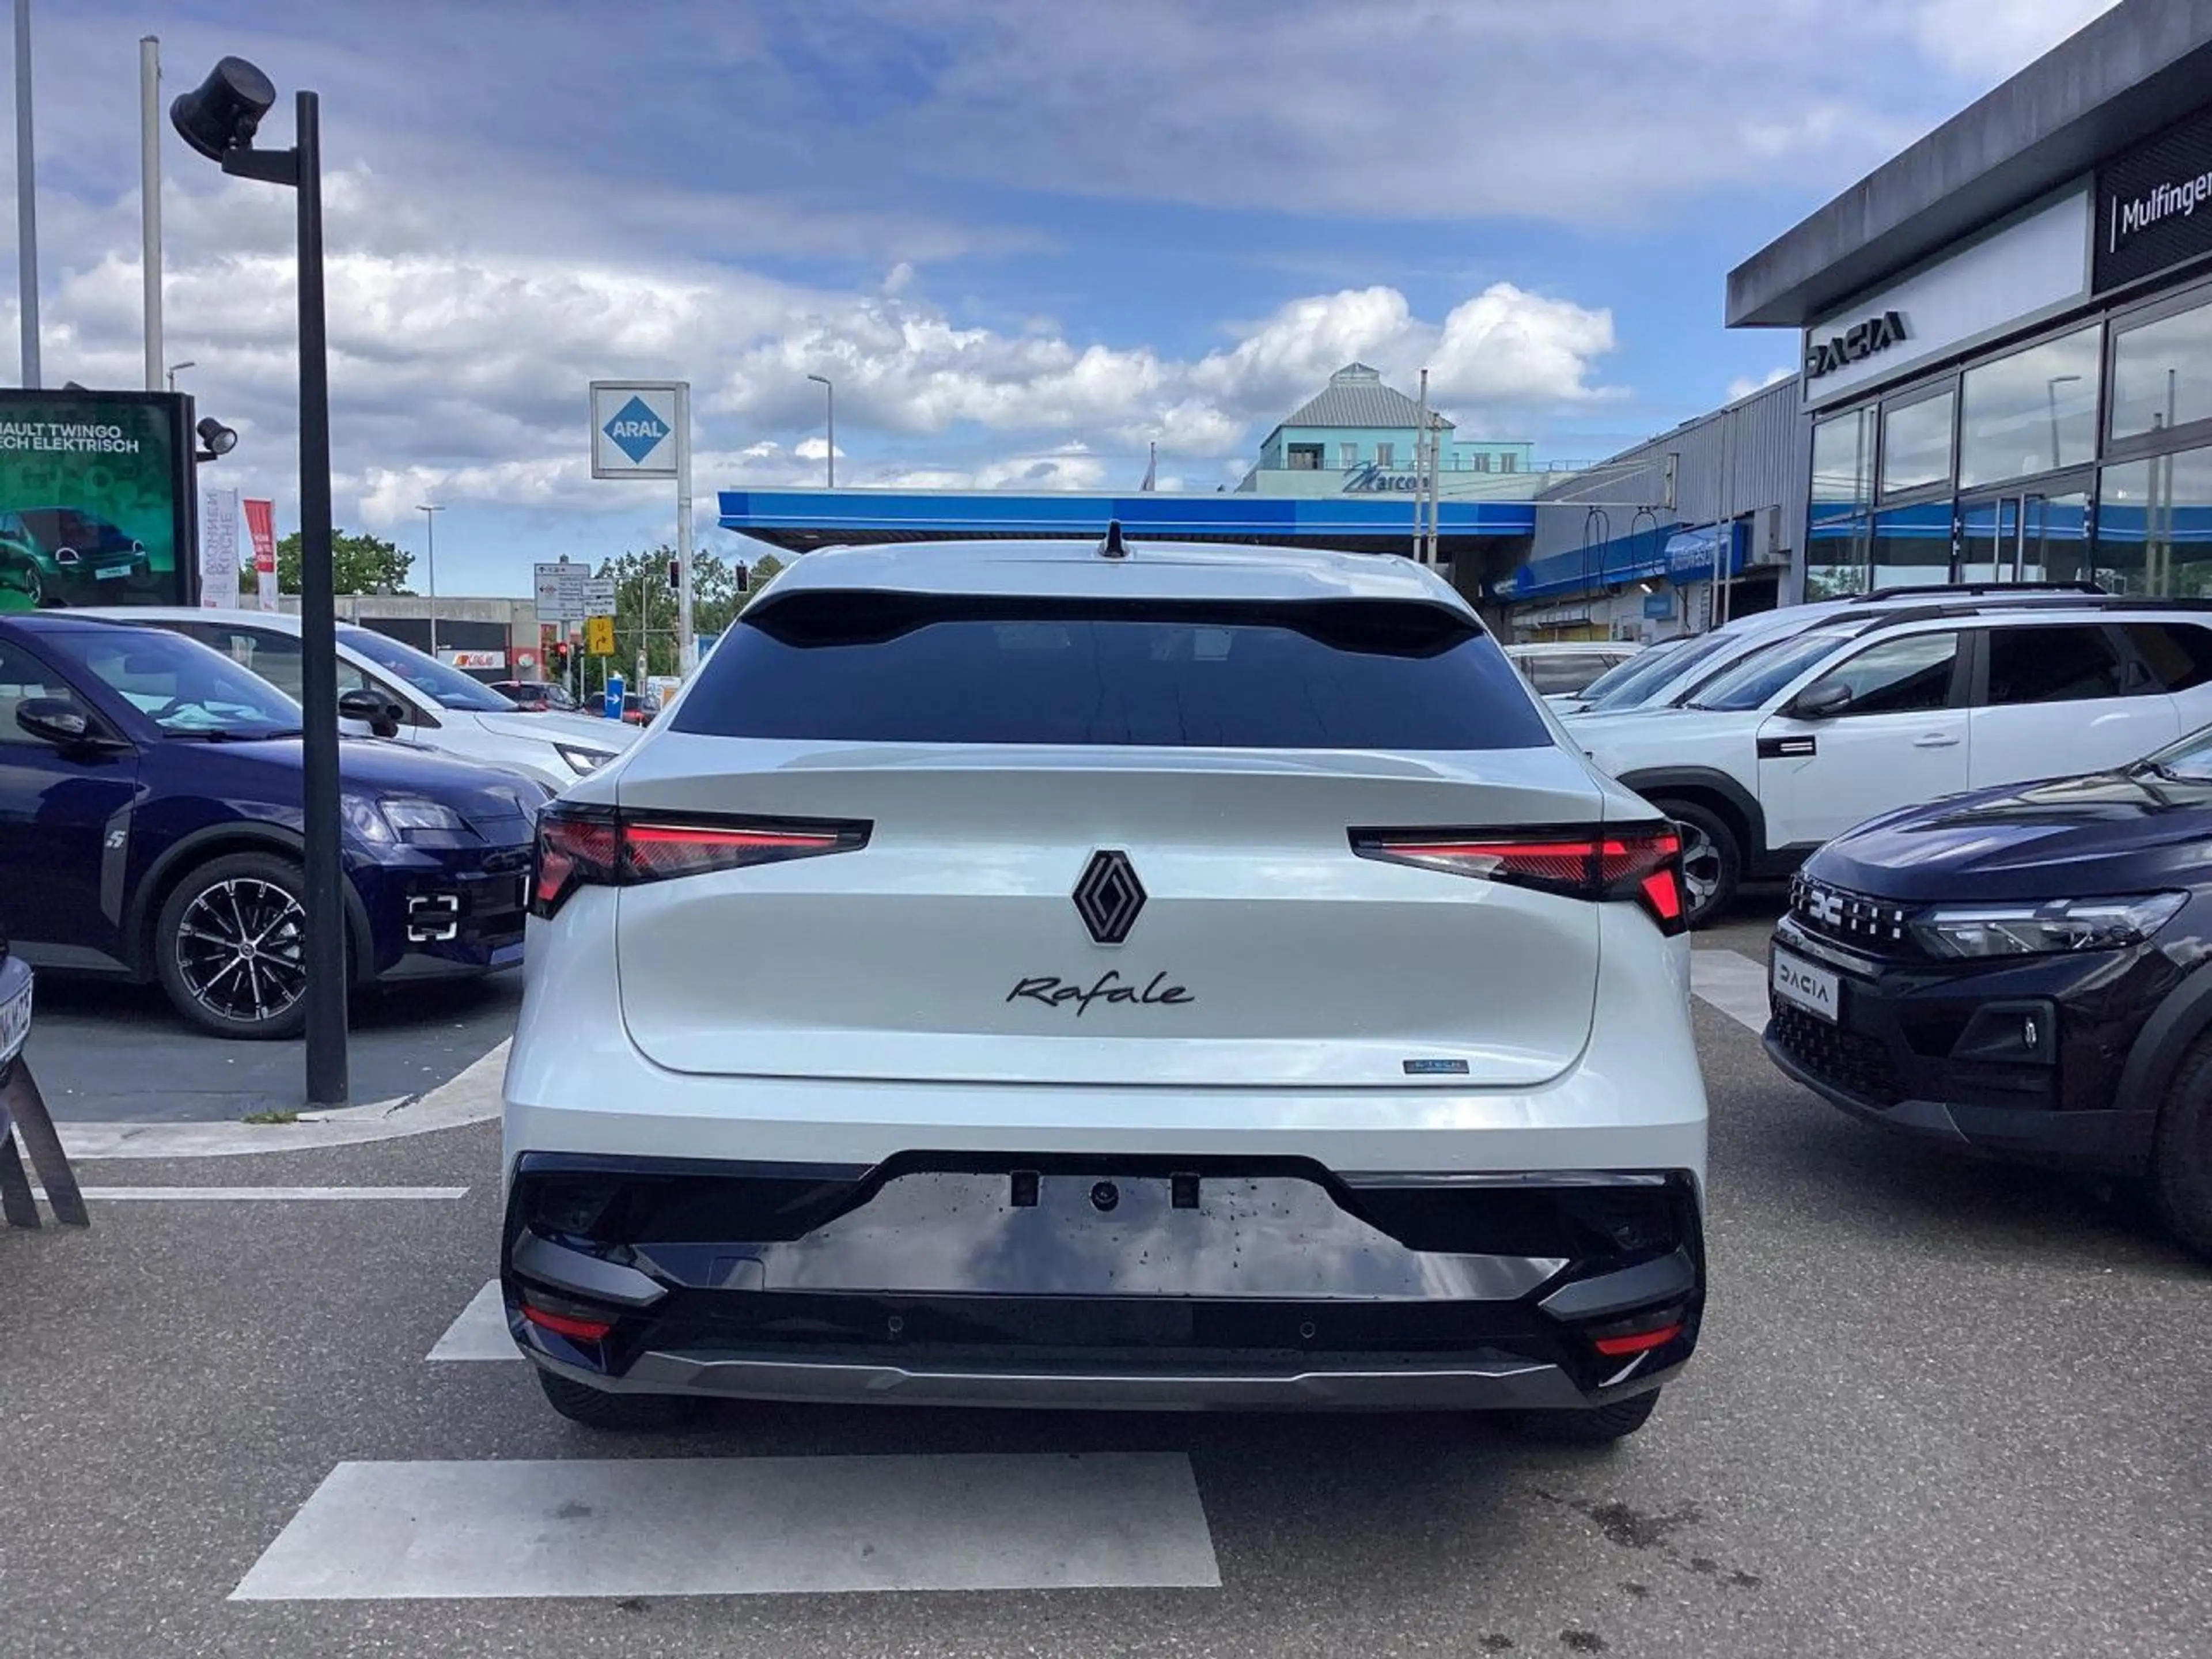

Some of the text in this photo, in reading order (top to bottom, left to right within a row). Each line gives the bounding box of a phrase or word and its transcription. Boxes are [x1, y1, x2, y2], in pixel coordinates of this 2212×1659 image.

[2122, 172, 2212, 234] Mulfinger
[1805, 311, 1906, 378] DACIA
[33, 437, 139, 453] ELEKTRISCH
[48, 423, 122, 439] TWINGO
[612, 421, 663, 438] ARAL
[1005, 969, 1195, 1017] Rafale
[1779, 964, 1829, 1003] DACIA
